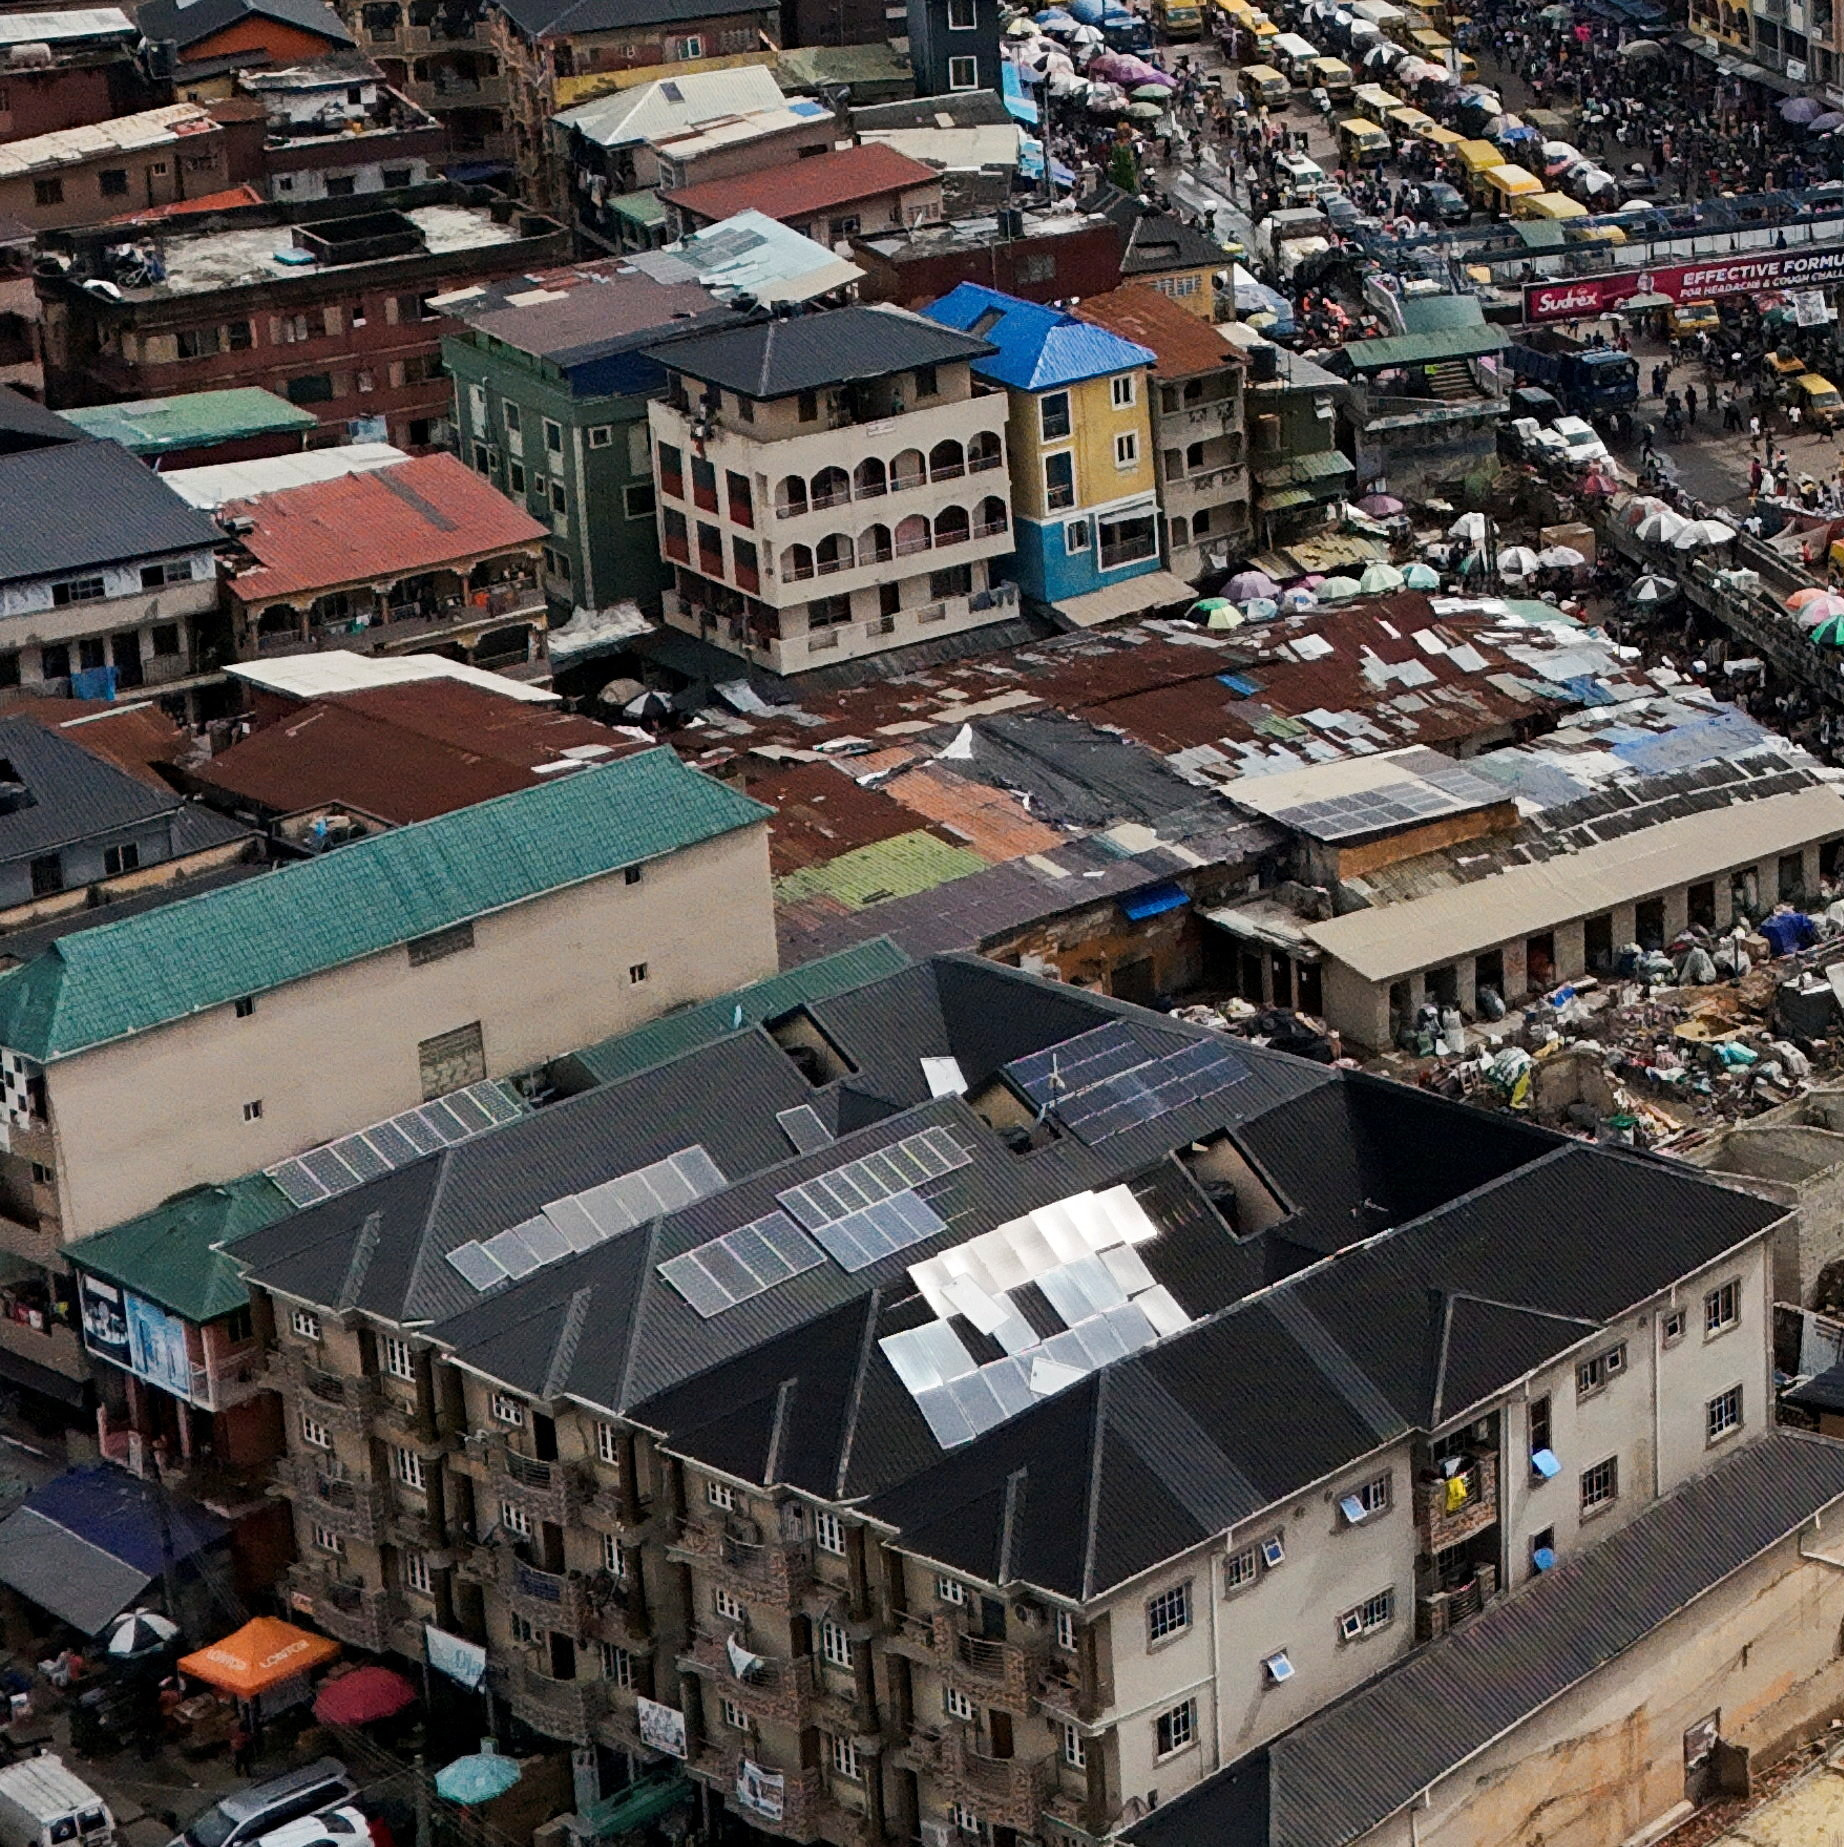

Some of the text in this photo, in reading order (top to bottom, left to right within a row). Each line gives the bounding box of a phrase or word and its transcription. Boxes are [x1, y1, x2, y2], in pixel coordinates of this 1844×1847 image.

[1683, 262, 1780, 285] EFFECTIVE
[1680, 287, 1701, 298] FOR
[1773, 274, 1809, 288] COUGH
[1538, 288, 1598, 312] Sudrex
